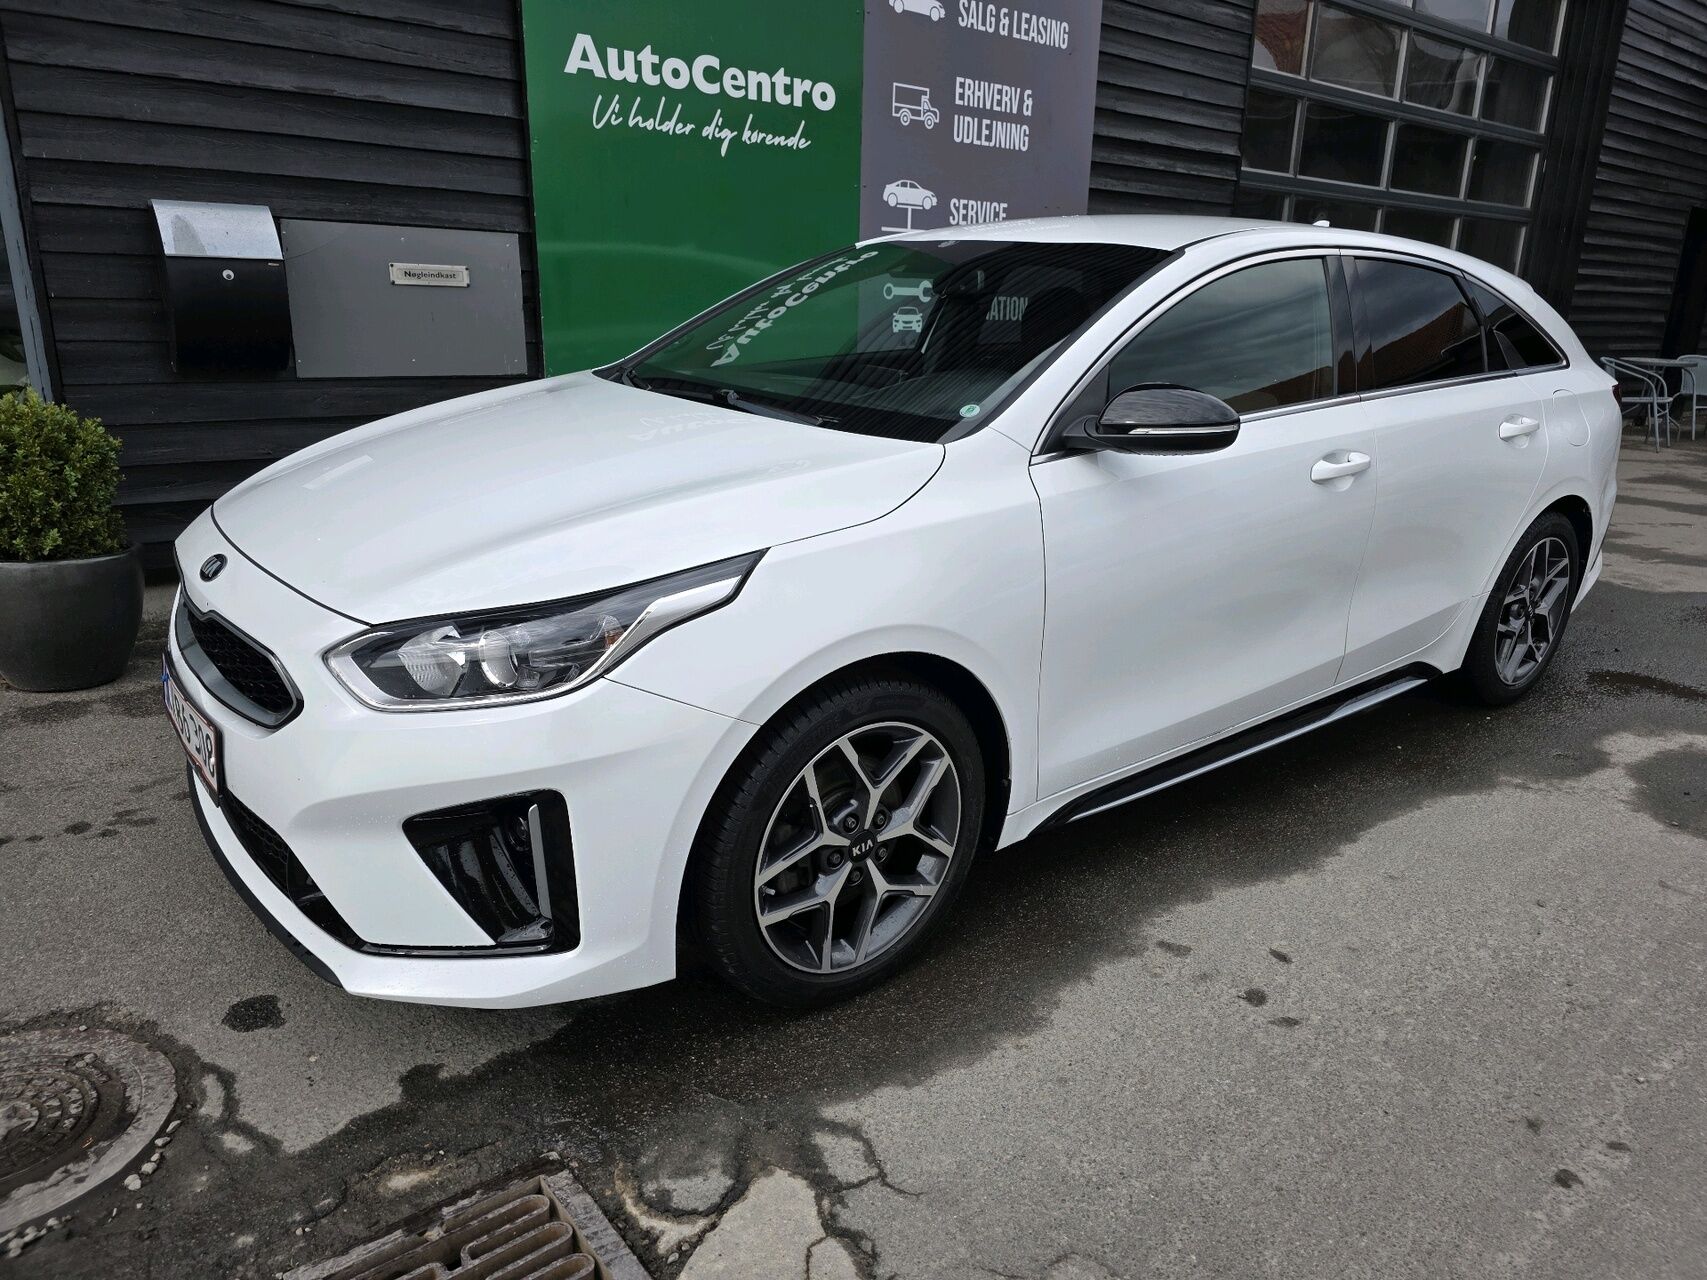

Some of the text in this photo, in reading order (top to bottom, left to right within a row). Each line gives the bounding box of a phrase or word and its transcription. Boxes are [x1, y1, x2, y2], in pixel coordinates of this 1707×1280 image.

[958, 0, 1069, 50] SALG & LEASING
[563, 33, 836, 111] AutoCentro
[955, 76, 1033, 117] ERHVERV &
[593, 94, 623, 129] Vi
[628, 96, 696, 135] holder
[702, 108, 738, 157] dig
[953, 114, 1030, 152] UDLEJNING
[949, 197, 1008, 226] SERVICE
[403, 270, 457, 280] Nøgleindkast
[852, 839, 874, 857] KIA
